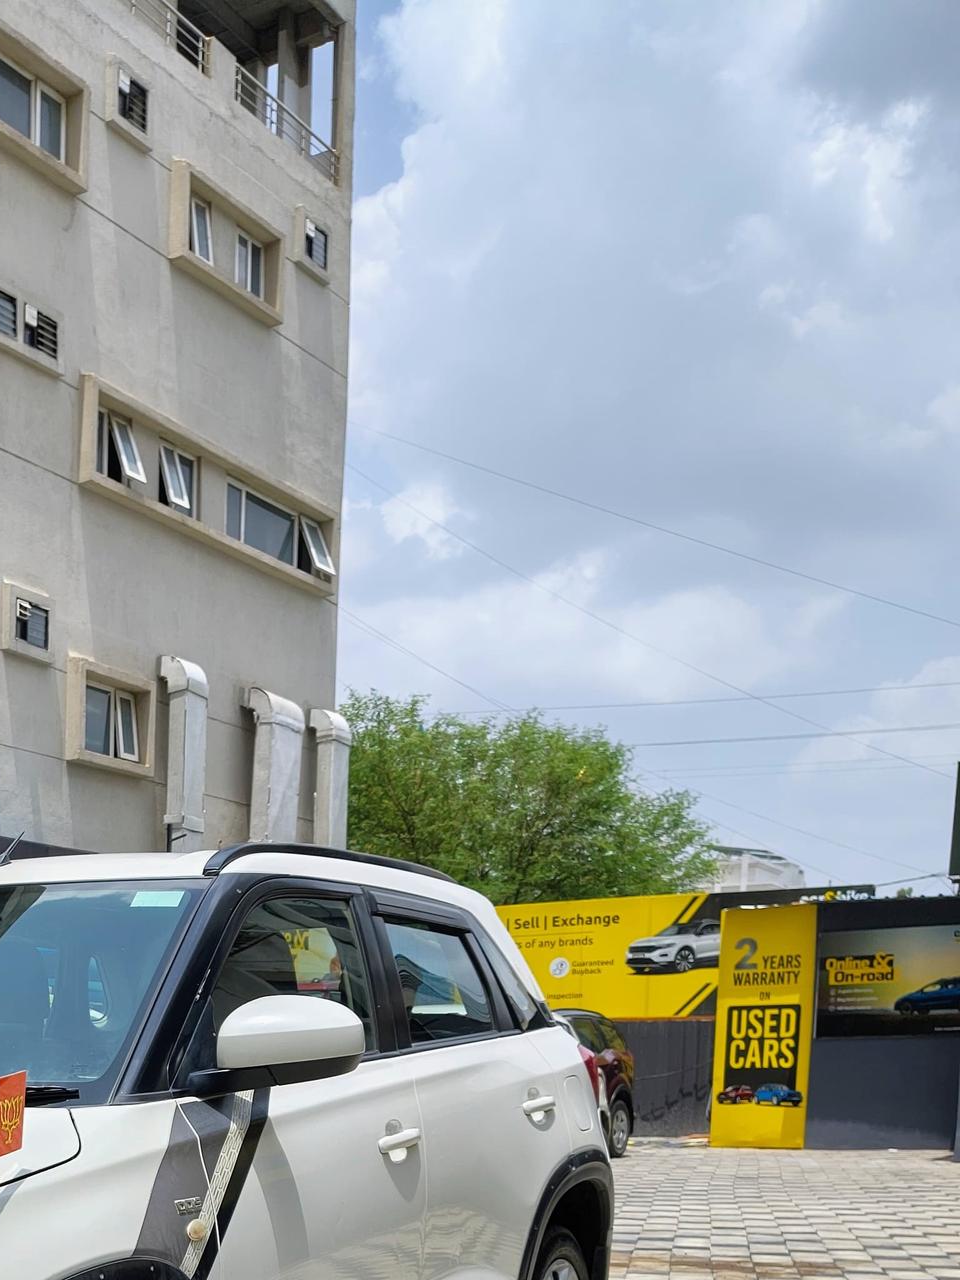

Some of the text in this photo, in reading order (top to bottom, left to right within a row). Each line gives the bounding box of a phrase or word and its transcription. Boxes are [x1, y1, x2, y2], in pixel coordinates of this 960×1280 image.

[514, 916, 540, 930] Sell
[552, 914, 620, 928] Exchange
[525, 939, 536, 948] of
[538, 940, 556, 949] any
[559, 936, 593, 947] brands
[734, 937, 801, 970] 2 YEARS
[572, 959, 614, 967] Guaranteed
[825, 956, 870, 971] Online
[572, 968, 601, 976] Buyback
[733, 970, 800, 986] WARRANTY
[834, 970, 894, 983] On-road
[759, 991, 771, 1000] ON
[731, 1008, 797, 1039] USED
[729, 1038, 795, 1069] CARS
